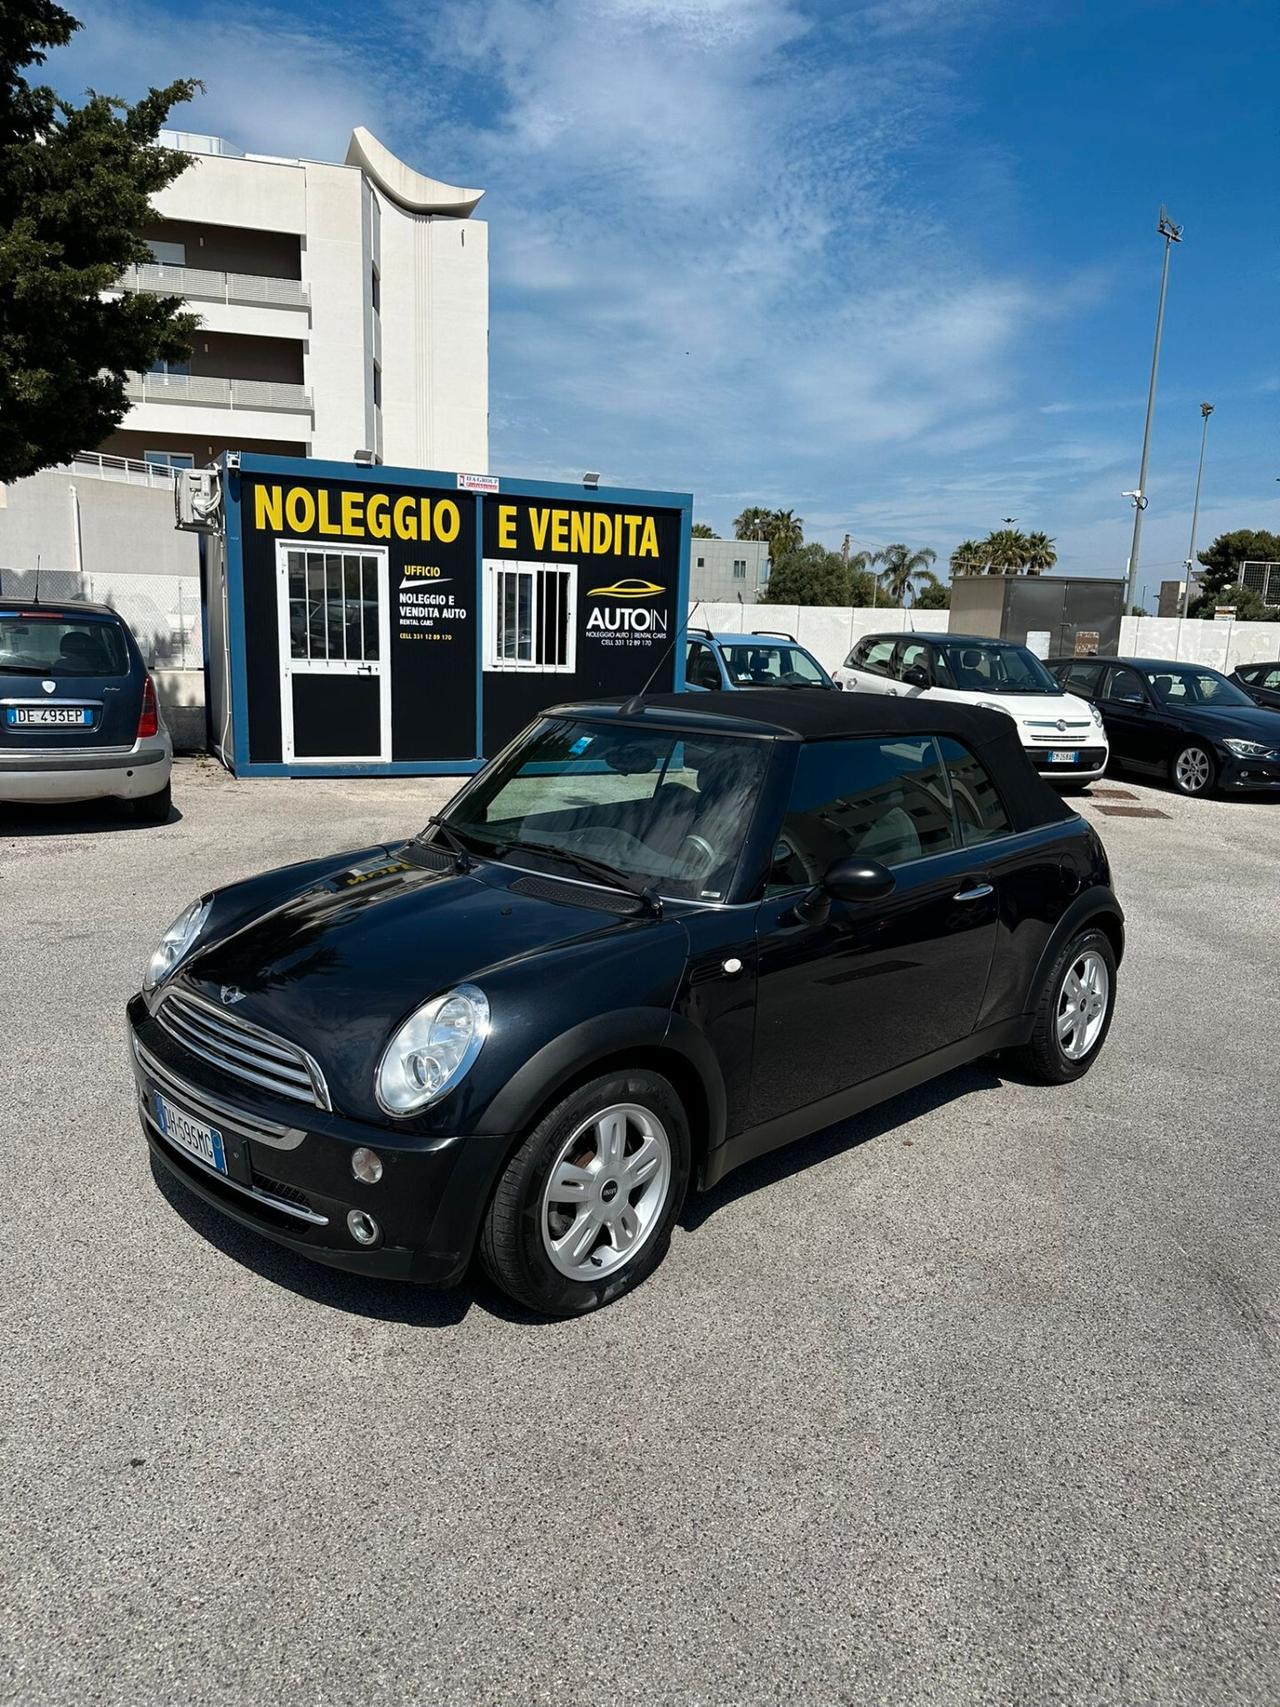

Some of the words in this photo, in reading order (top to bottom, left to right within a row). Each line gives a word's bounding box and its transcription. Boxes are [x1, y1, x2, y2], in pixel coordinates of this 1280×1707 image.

[254, 484, 461, 543] NOLEGGIO
[498, 505, 517, 549] E
[528, 507, 660, 558] VENDITA
[404, 565, 441, 577] UFFICIO
[399, 592, 446, 605] NOLEGGIO
[448, 595, 455, 606] E
[399, 606, 439, 618] VENDITA
[442, 608, 467, 619] AUTO
[18, 709, 35, 722] DE
[41, 709, 82, 722] 493EP
